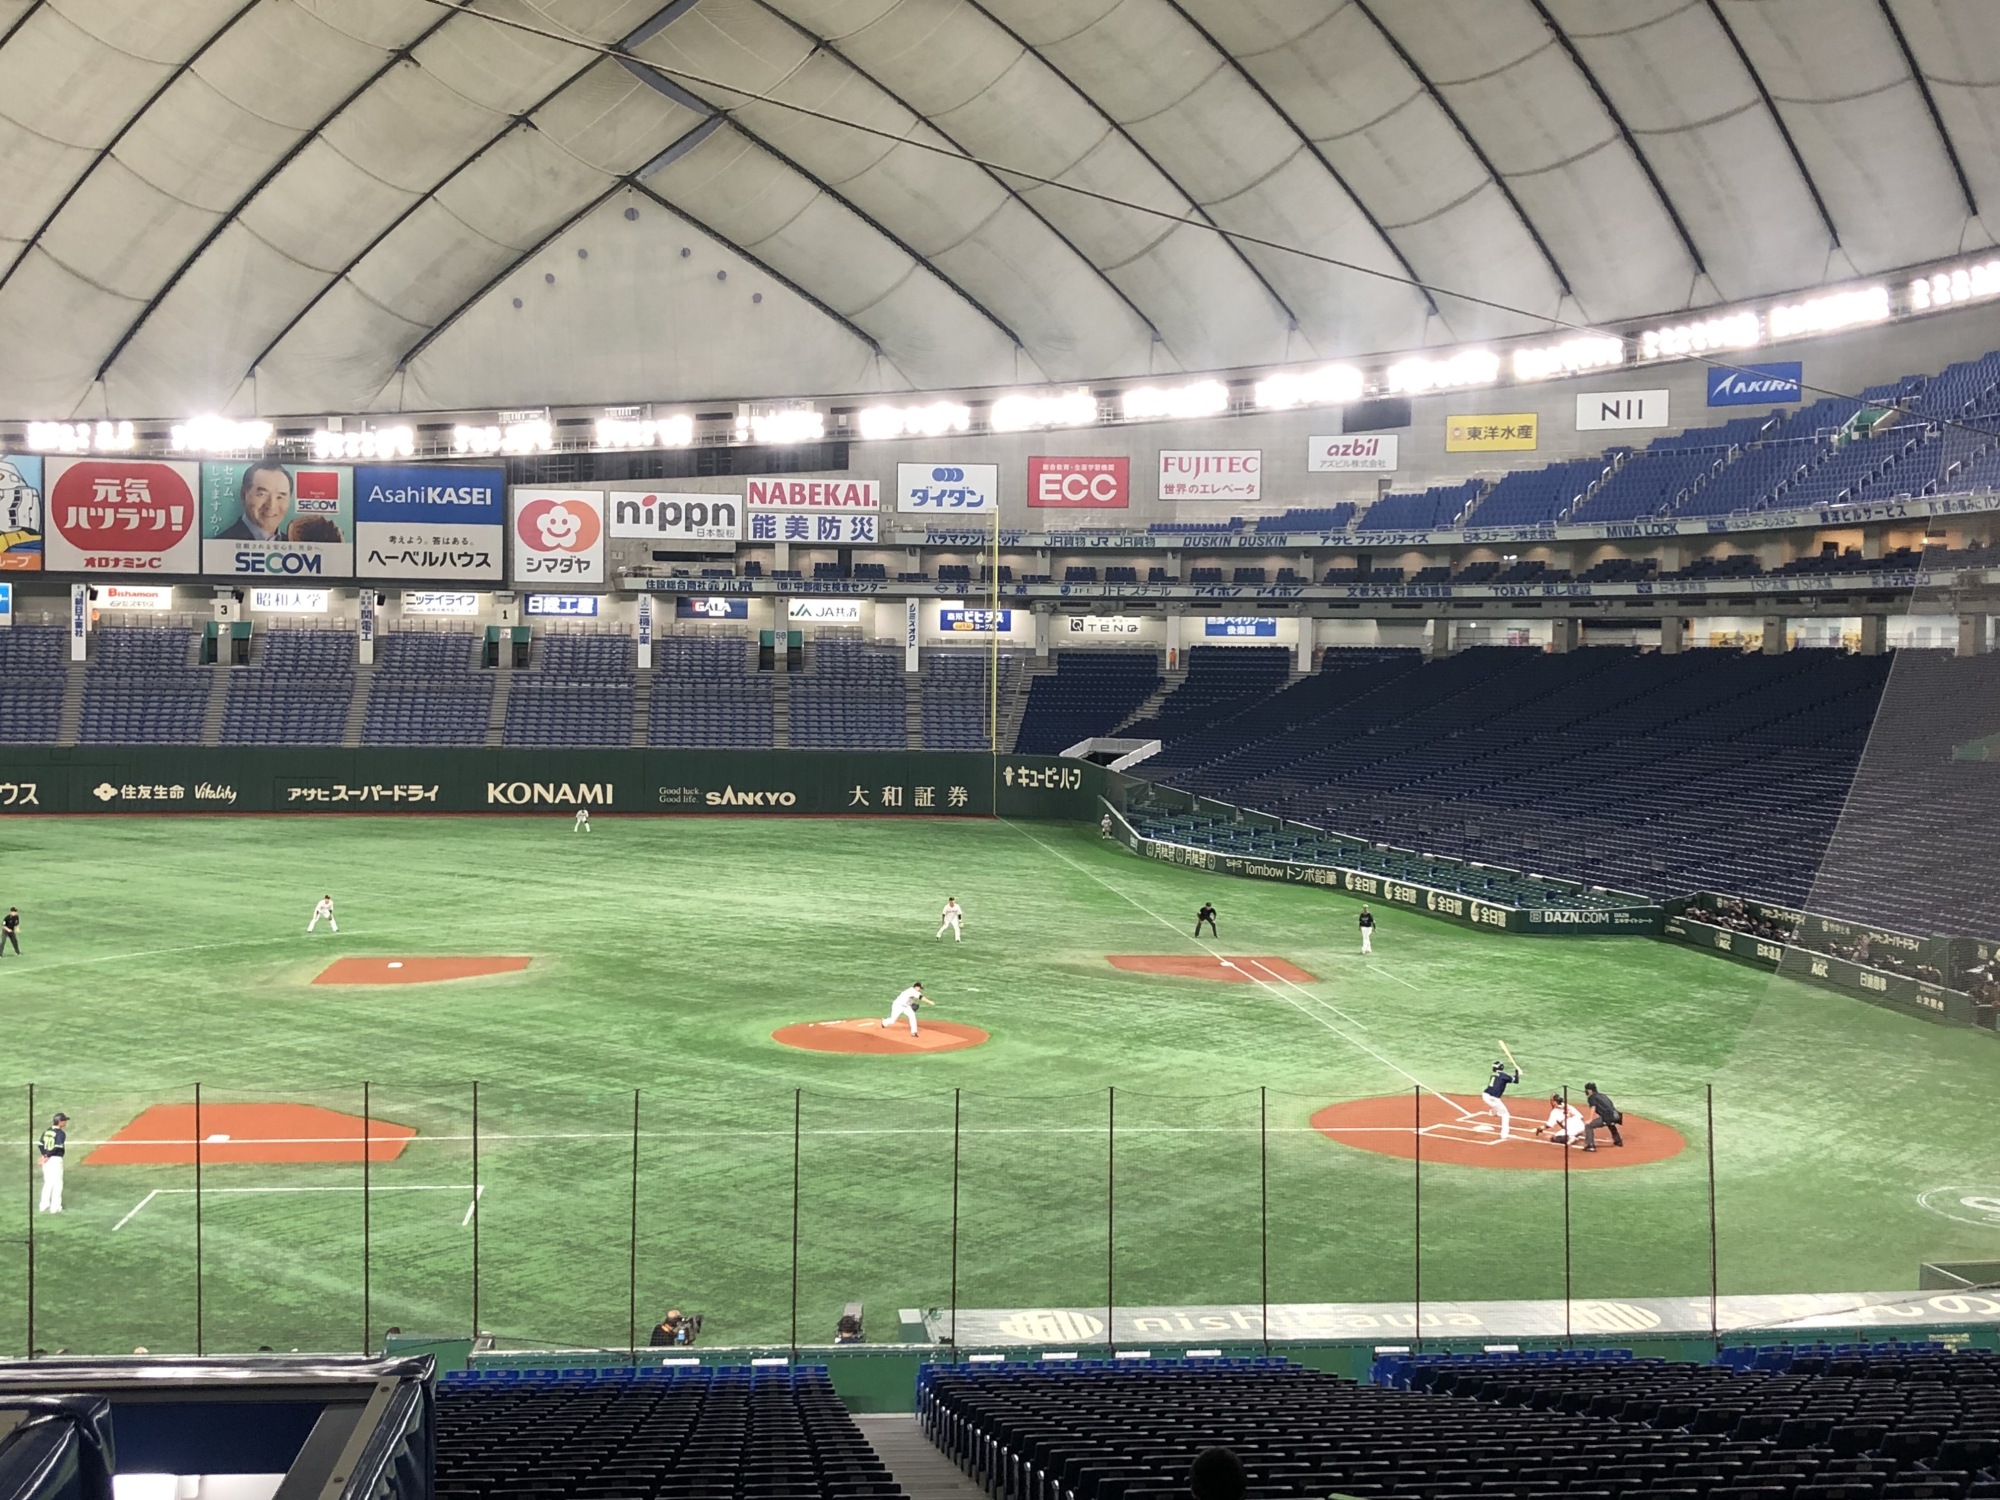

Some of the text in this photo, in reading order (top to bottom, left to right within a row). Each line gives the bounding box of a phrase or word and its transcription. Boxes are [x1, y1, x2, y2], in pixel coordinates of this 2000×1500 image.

[1733, 379, 1799, 394] AKIRA
[1466, 424, 1533, 441] 東洋水産
[1325, 438, 1379, 458] azbil
[1162, 456, 1259, 480] FUJITEC
[1318, 458, 1387, 469] アズビル株式会社
[92, 478, 152, 504] 元気
[749, 481, 878, 507] NABEKAI.
[1039, 473, 1117, 501] ECC
[1163, 483, 1256, 495] 世界のエレベータ
[298, 500, 337, 510] SECOM
[910, 486, 984, 507] ダイダン
[616, 494, 736, 532] nippn
[696, 528, 736, 538] 日本製粉
[752, 514, 875, 541] 能美防災
[1606, 523, 1680, 538] MIWA LOCK
[1044, 536, 1156, 548] JR貨物 JR JR貨物
[1183, 535, 1288, 547] DUSKIN DUSKIN
[83, 556, 162, 569] オロナミンC
[235, 551, 322, 574] SECOM
[368, 550, 492, 569] ヘーベルハウス
[525, 555, 591, 574] シマダヤ
[108, 587, 159, 598] Bishamon
[256, 592, 321, 607] 昭和大学
[406, 593, 475, 606] ニッテイライフ
[220, 604, 228, 615] 3
[528, 597, 594, 614] 日総工産
[502, 610, 508, 620] 1
[361, 610, 372, 641] 関電工
[639, 607, 650, 645] 三機工業
[908, 603, 917, 649] シミズオクト
[120, 782, 237, 804] 住友生命 Vitality
[287, 785, 440, 802] アサヒスーパードライ
[487, 782, 613, 804] KONAMI
[659, 786, 681, 795] Good
[659, 795, 681, 803] Good
[706, 784, 796, 806] SANKYO
[848, 785, 969, 807] 大和証券
[1245, 861, 1338, 886] Tombow トンボ鉛筆
[1544, 911, 1610, 923] DAZN.COM
